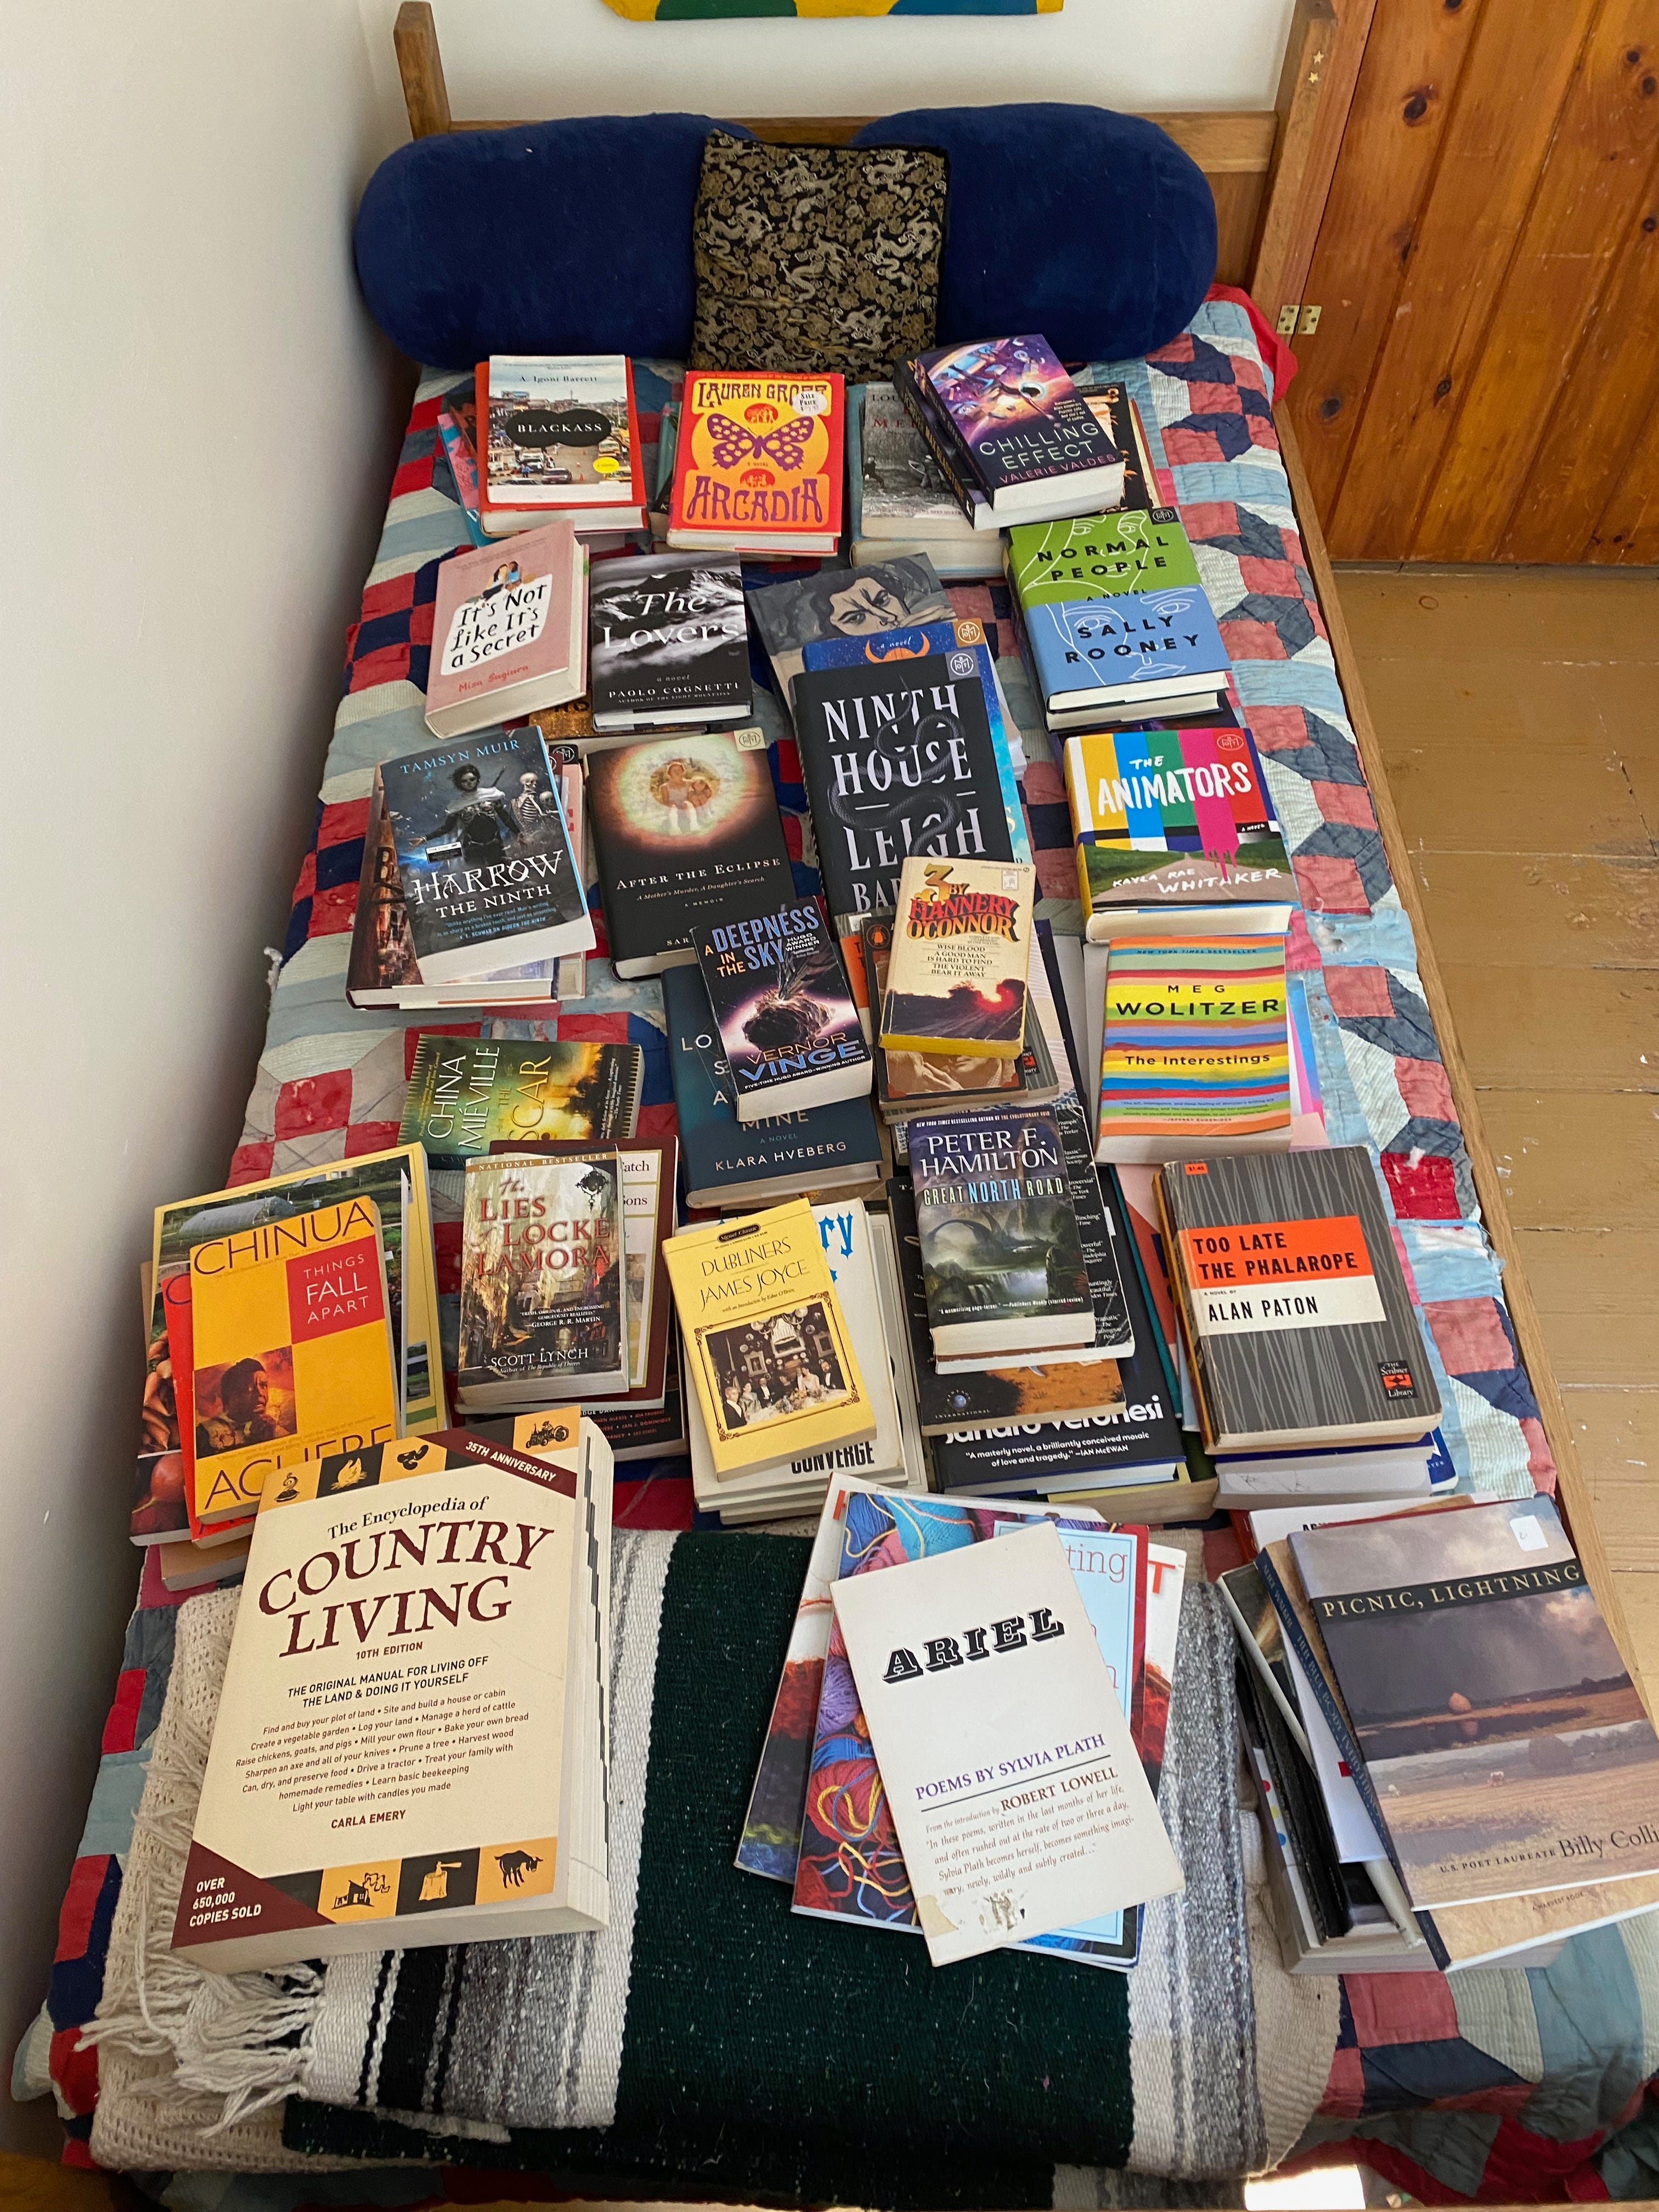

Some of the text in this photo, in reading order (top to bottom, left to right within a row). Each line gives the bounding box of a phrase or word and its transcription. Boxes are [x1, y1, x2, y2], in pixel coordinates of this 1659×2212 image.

[533, 375, 559, 383] Igoni
[563, 374, 597, 383] Barrett
[698, 382, 761, 408] LAUREN
[517, 422, 603, 434] BLACKASS
[980, 422, 1099, 455] CHILLING
[999, 453, 1115, 483] VALERIE VALDES
[1002, 439, 1094, 470] EFFECT
[687, 475, 823, 522] ARCADIA
[1037, 537, 1169, 562] NORMAL
[1051, 557, 1167, 581] PEOPLE
[461, 584, 547, 627] It's Not
[636, 591, 707, 615] The
[1103, 589, 1147, 599] NOVEL
[451, 607, 538, 652] Like It's
[603, 621, 740, 650] Lovers
[1077, 616, 1173, 637] SALLY
[452, 624, 539, 667] a Secret
[1065, 634, 1199, 663] ROONEY
[459, 664, 529, 692] Misa Sugiura
[609, 682, 738, 698] PAOLO COGNETTI
[822, 685, 959, 742] NINTH
[400, 739, 520, 774] TAMSYN MUIR
[831, 737, 972, 796] HOUSE
[1129, 756, 1164, 769] THE
[1098, 762, 1251, 816] ANIMATORS
[843, 808, 986, 871] LEIGH
[414, 849, 563, 905] HARROW
[616, 859, 781, 890] AFTER THE ECLIPSE
[915, 863, 969, 906] 3 BY
[1113, 868, 1194, 887] KAYLA RAE
[1158, 868, 1283, 893] WHITAKER
[436, 884, 551, 918] THE NINTH
[910, 893, 1020, 922] FLANNERY
[704, 906, 820, 956] A DEEPNESS
[907, 914, 1019, 942] O'CONNOR
[720, 939, 785, 971] IN SKY
[717, 963, 746, 978] THE
[1168, 985, 1225, 993] MEG
[1116, 1000, 1278, 1015] WOLITZER
[739, 1040, 864, 1082] VINGE
[747, 1032, 848, 1064] VERNOR
[1125, 1053, 1270, 1065] The Interestings
[427, 1055, 466, 1138] CHINA
[458, 1046, 500, 1149] MIÉVILLE
[715, 1141, 847, 1171] KLARA HVEBERG
[927, 1128, 1046, 1155] PETER F.
[479, 1153, 607, 1170] NATIONAL BESTSELLER
[920, 1147, 1059, 1177] HAMILTON
[923, 1178, 1064, 1206] GREAT NORTH ROAD
[481, 1196, 546, 1221] LIES
[194, 1201, 374, 1276] CHINUA
[503, 1218, 610, 1245] LOCKE
[1193, 1233, 1286, 1254] TOO LATE
[304, 1254, 365, 1279] THINGS
[478, 1245, 610, 1276] LAMORA
[701, 1237, 791, 1277] DUBLINERS
[1199, 1252, 1358, 1280] THE PHALAROPE
[306, 1273, 368, 1305] FALL
[700, 1260, 810, 1313] JAMES JOYCE
[307, 1296, 369, 1324] APART
[532, 1319, 558, 1328] GEORGE
[575, 1316, 600, 1324] MARTIN
[1209, 1296, 1318, 1322] ALAN PATON
[491, 1348, 588, 1368] SCOTT LYNCH
[466, 1441, 557, 1482] 35TH ANNIVERSARY
[991, 1458, 999, 1467] of
[1001, 1457, 1017, 1465] love
[1018, 1455, 1034, 1464] and
[328, 1497, 489, 1539] The Encyclopedia of
[259, 1519, 555, 1616] COUNTRY
[1323, 1565, 1581, 1618] PICNIC, LIGHTNING
[279, 1576, 511, 1657] LIVING
[356, 1641, 423, 1660] 10TH EDITION
[882, 1607, 1064, 1683] ARIEL
[287, 1657, 489, 1699] THE ORIGINAL MANUAL FOR LIVING OFF
[915, 1734, 1105, 1801] POEMS BY SYLVIA PLATH
[293, 1781, 451, 1812] Light your table with candles you made
[1001, 1767, 1118, 1810] ROBERT LOWELL
[331, 1810, 406, 1829] CARLA EMERY
[1440, 1865, 1457, 1873] U.S.
[1462, 1859, 1490, 1871] POET
[1497, 1849, 1556, 1865] LAUREATE
[1559, 1834, 1604, 1858] Billy
[196, 1877, 224, 1892] OVER
[189, 1904, 262, 1927] COPIES SOLD
[193, 1892, 235, 1909] 650,000
